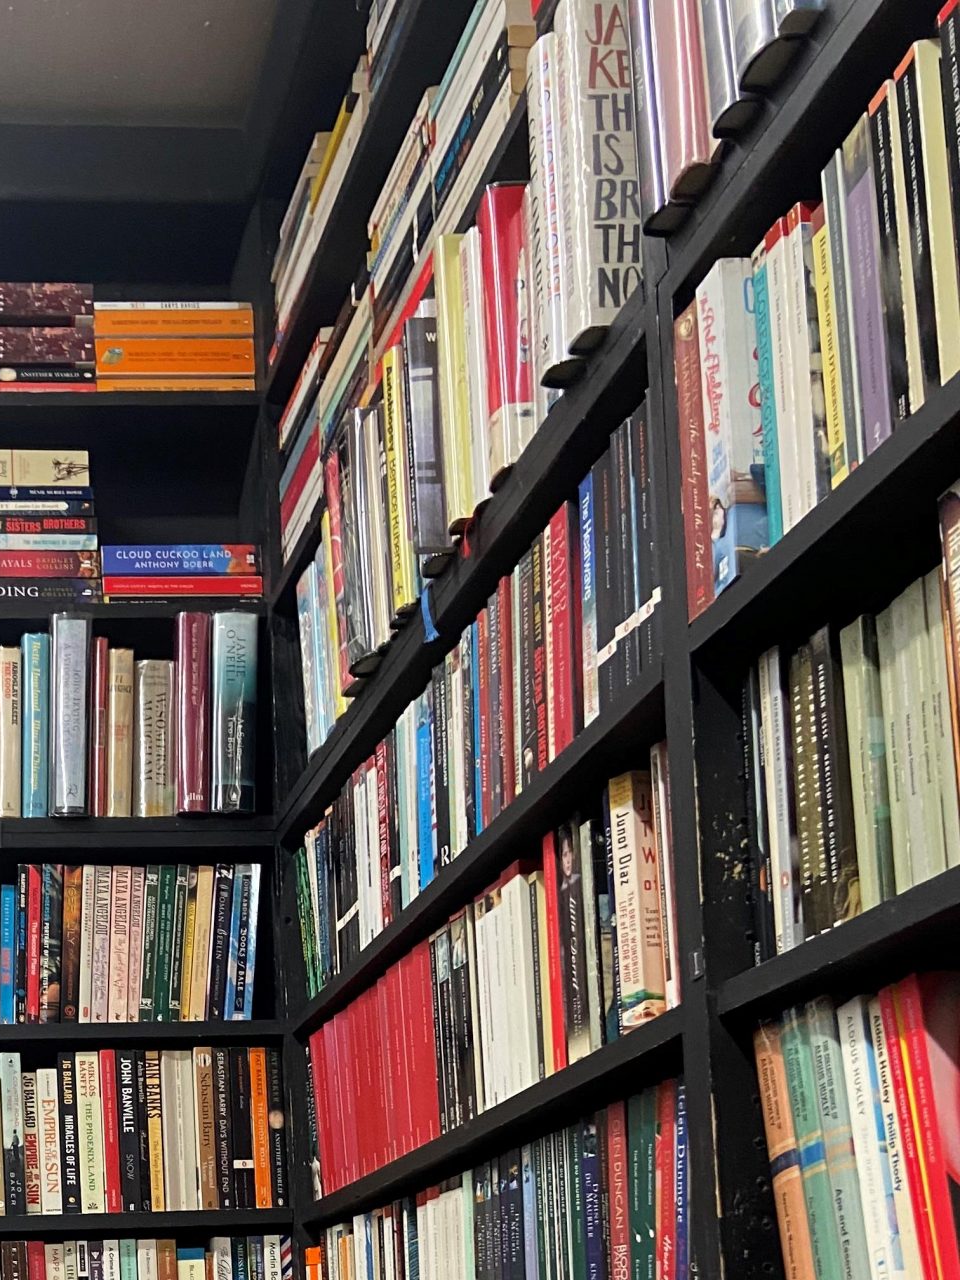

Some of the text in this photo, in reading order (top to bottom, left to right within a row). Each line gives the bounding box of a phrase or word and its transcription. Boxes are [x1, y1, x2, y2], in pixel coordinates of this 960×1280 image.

[5, 519, 86, 533] SISTERS BROTHERS
[116, 550, 232, 562] CLOUD CUCKOO LAND
[134, 560, 214, 569] ANTHONY DOERR
[616, 811, 630, 851] Junot
[114, 870, 128, 936] MAYA ANGELOU
[120, 1057, 134, 1133] JOHN BANVILLE
[872, 1014, 903, 1192] Aldous Huxley Philip Thody
[65, 1115, 76, 1185] MIRACLES OF LIFE
[268, 1242, 277, 1271] Martin
